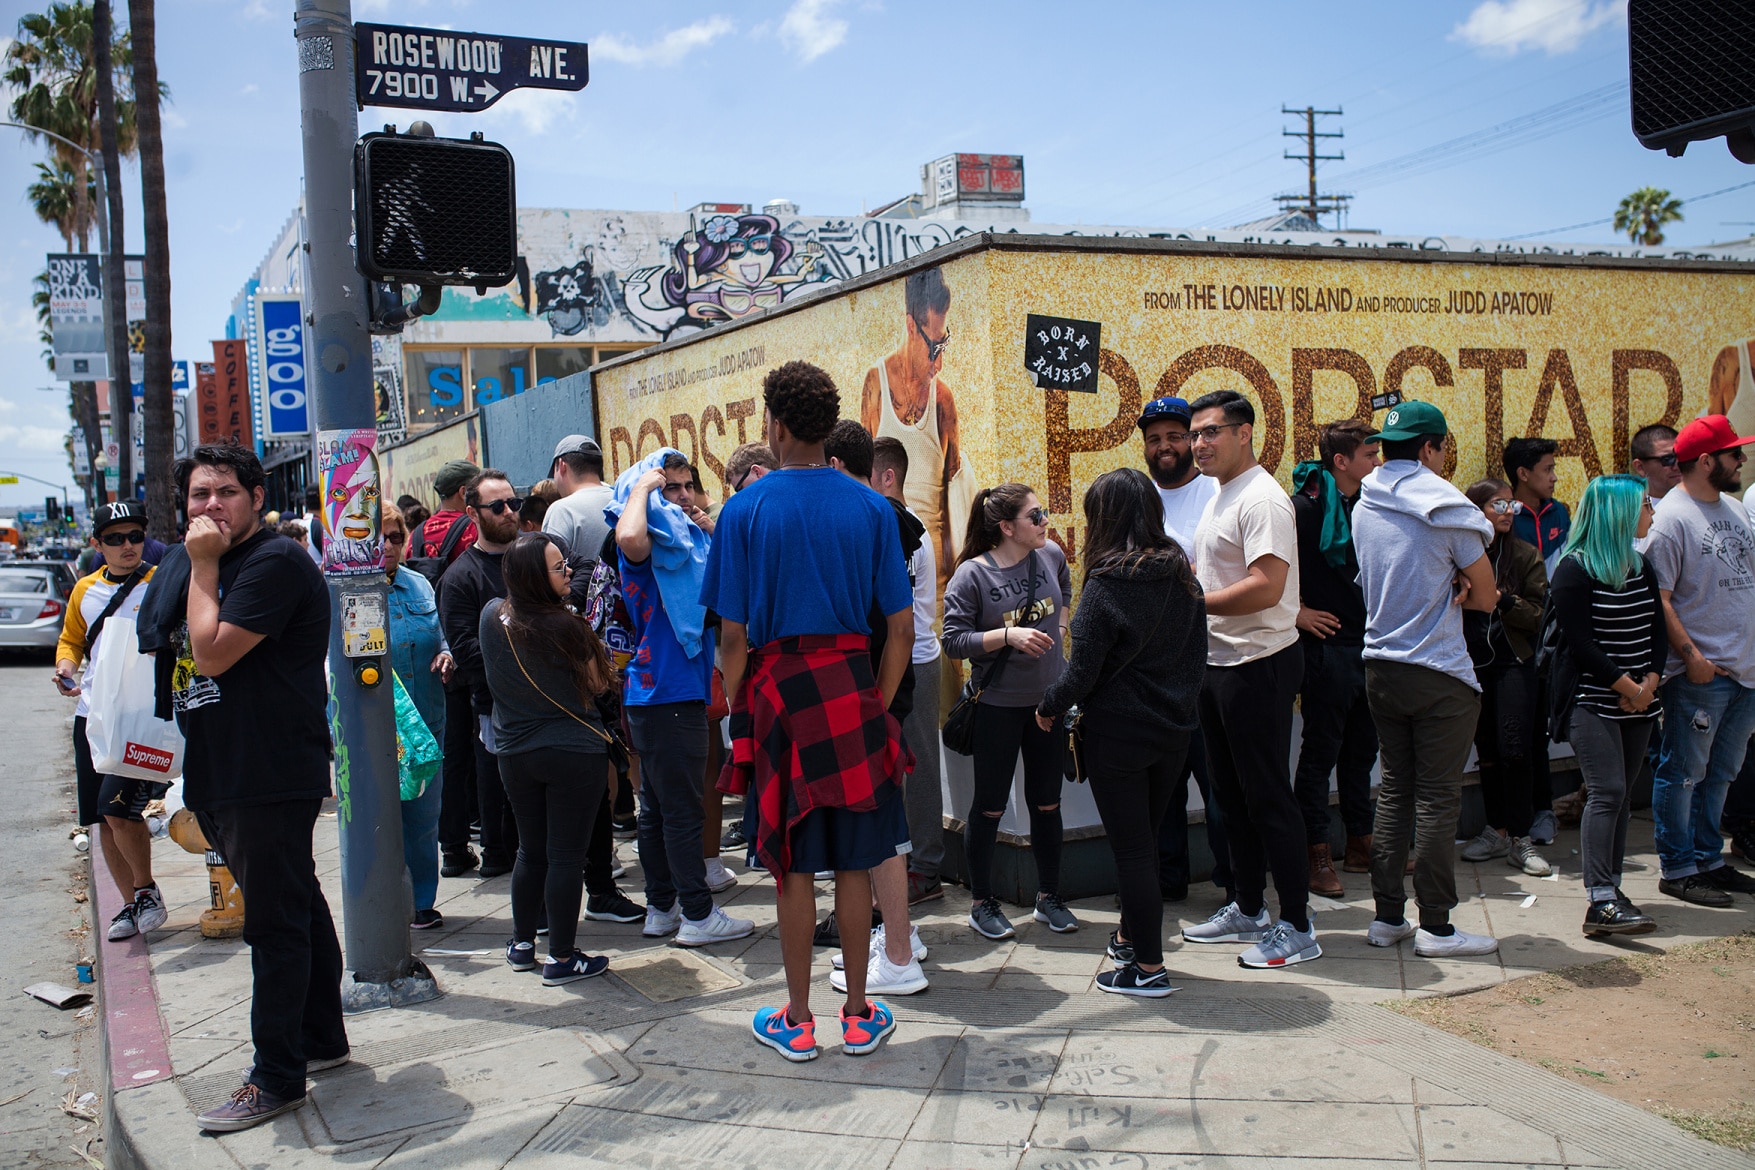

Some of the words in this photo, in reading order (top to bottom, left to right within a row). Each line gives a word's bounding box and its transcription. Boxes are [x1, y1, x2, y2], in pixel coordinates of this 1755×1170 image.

[372, 31, 502, 74] ROSEWOOD
[529, 45, 576, 81] AVE.
[366, 70, 439, 100] 7900
[48, 259, 88, 275] ONE
[49, 271, 74, 286] OF
[76, 272, 92, 287] A
[50, 283, 100, 300] KIND
[1143, 291, 1182, 310] FROM
[1184, 284, 1217, 310] THE
[1222, 285, 1287, 311] LONELY
[1290, 287, 1354, 313] ISLAND
[1355, 297, 1381, 313] AND
[1383, 297, 1442, 314] PRODUCER
[1444, 290, 1487, 315] JUDD
[1490, 291, 1554, 316] APATOW
[1037, 325, 1090, 350] BORN
[667, 368, 687, 391] ISLAND
[718, 354, 736, 378] JUDD
[737, 345, 766, 371] APATOW
[1032, 355, 1092, 383] RAISED
[1045, 344, 1684, 514] POPSTAR
[126, 744, 171, 768] Supreme
